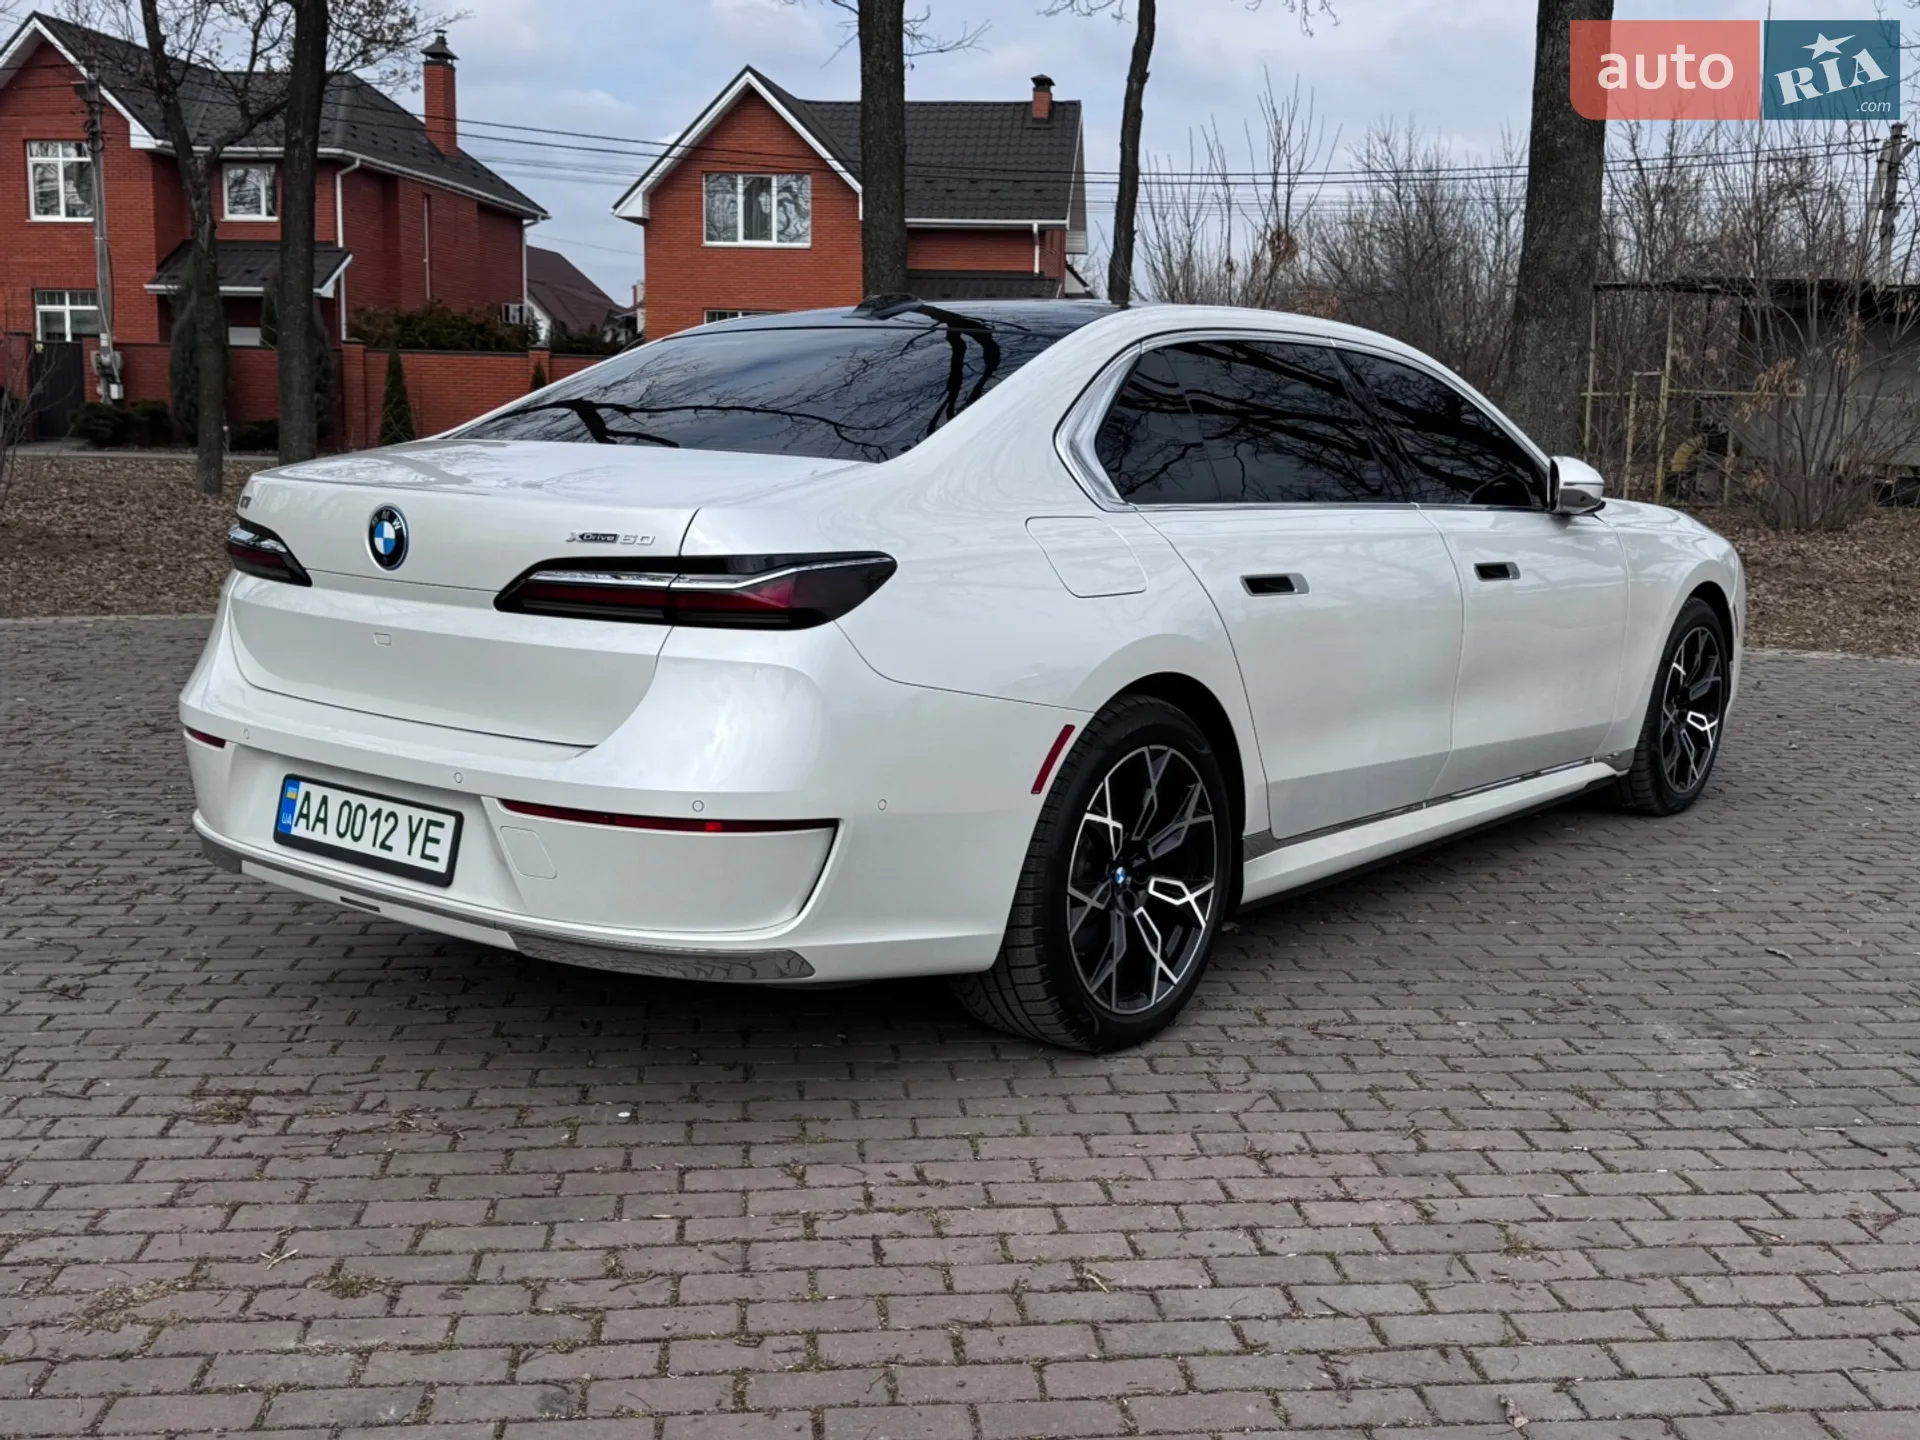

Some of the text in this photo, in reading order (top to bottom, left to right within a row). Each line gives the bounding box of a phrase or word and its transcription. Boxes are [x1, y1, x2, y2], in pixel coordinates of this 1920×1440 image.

[281, 812, 293, 826] UA
[294, 790, 446, 864] AA 0012 YE
